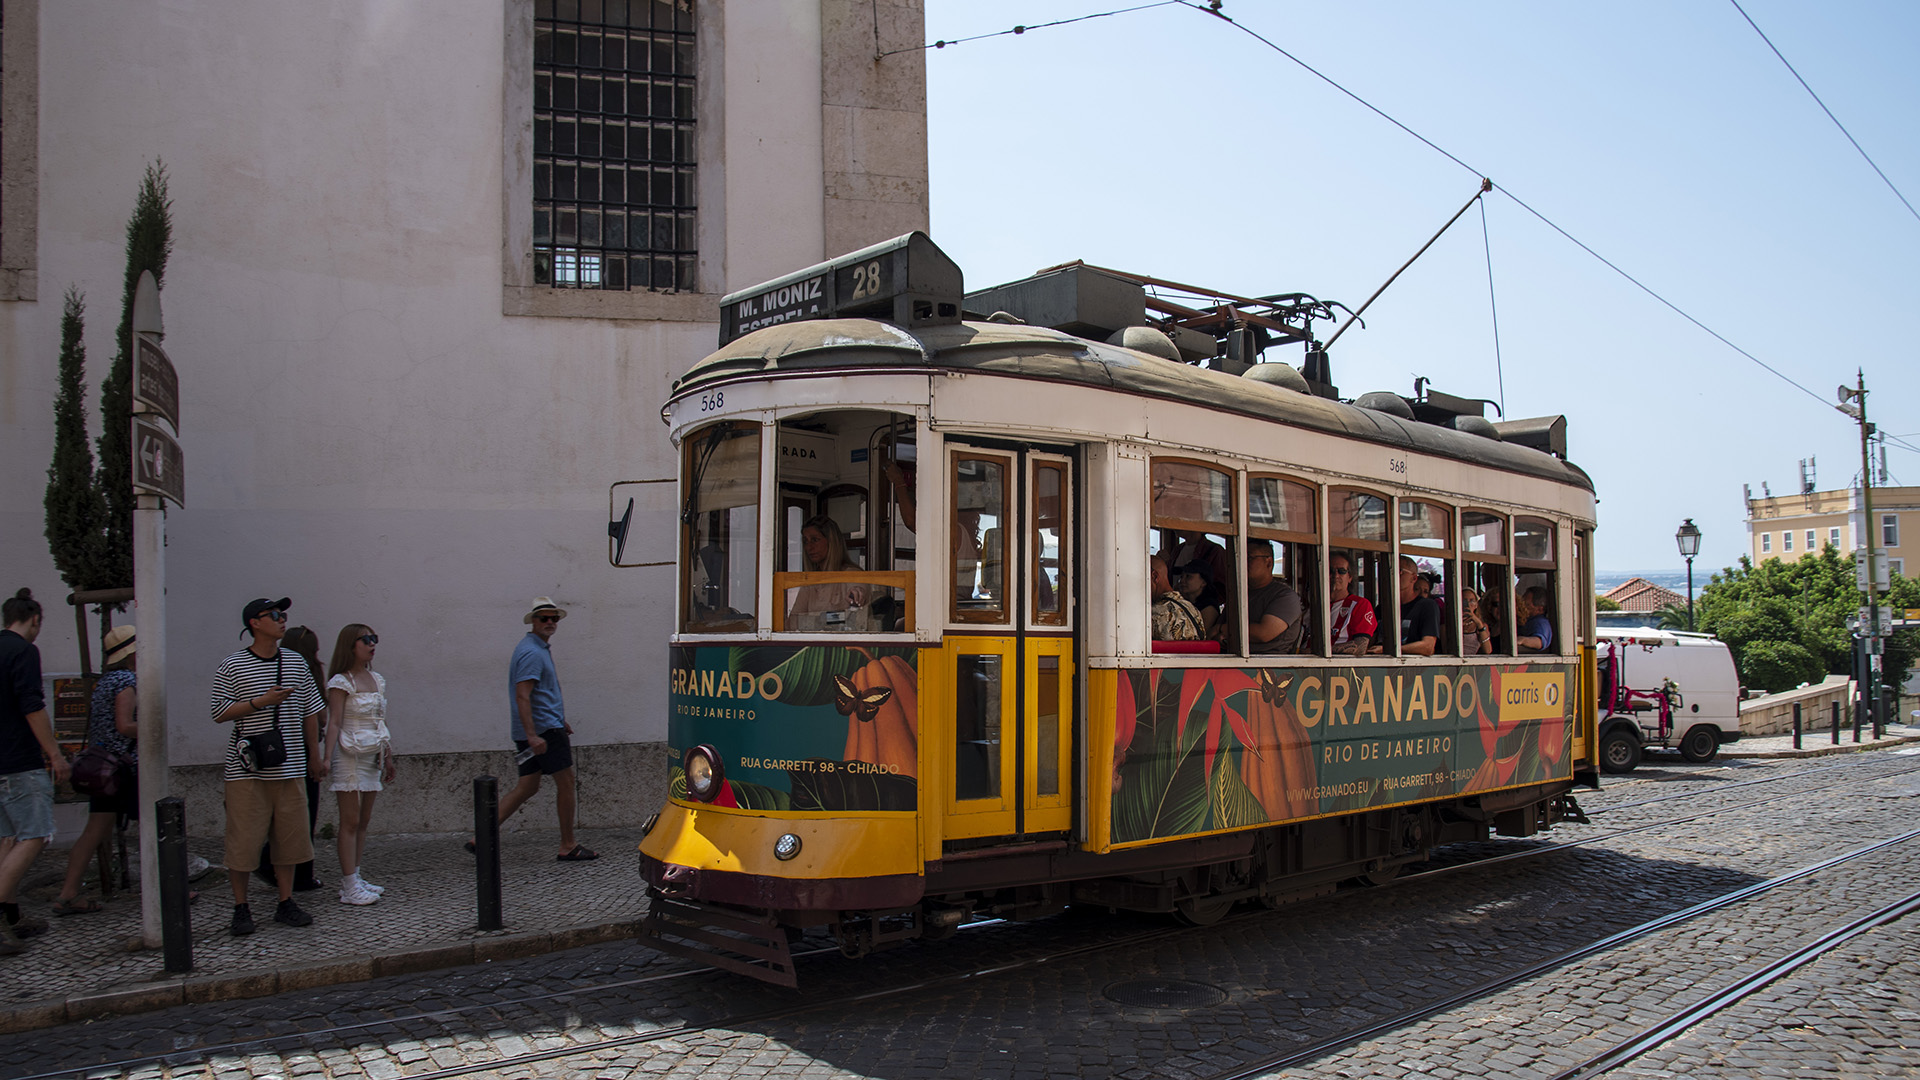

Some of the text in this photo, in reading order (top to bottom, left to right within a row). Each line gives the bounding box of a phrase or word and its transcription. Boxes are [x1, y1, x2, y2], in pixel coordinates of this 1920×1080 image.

[852, 260, 881, 301] 28
[739, 276, 822, 319] M. MONIZ
[701, 391, 724, 412] 568
[1389, 458, 1405, 473] 568
[671, 667, 783, 701] GRANADO
[1506, 681, 1539, 705] carris
[677, 704, 756, 721] RIO DE JANEIRO
[1296, 673, 1478, 728] GRANADO
[1324, 736, 1452, 764] RIO DE JANEIRO
[740, 756, 762, 769] RUA
[763, 758, 817, 774] GARRETT,
[819, 762, 835, 773] 98
[847, 762, 901, 775] CHIADO
[1286, 780, 1369, 802] WWW.GRANADO.EU
[1383, 777, 1400, 791] RUA
[1400, 772, 1434, 788] GARRETT,
[1435, 771, 1444, 784] 98
[1450, 767, 1477, 782] CHIADO
